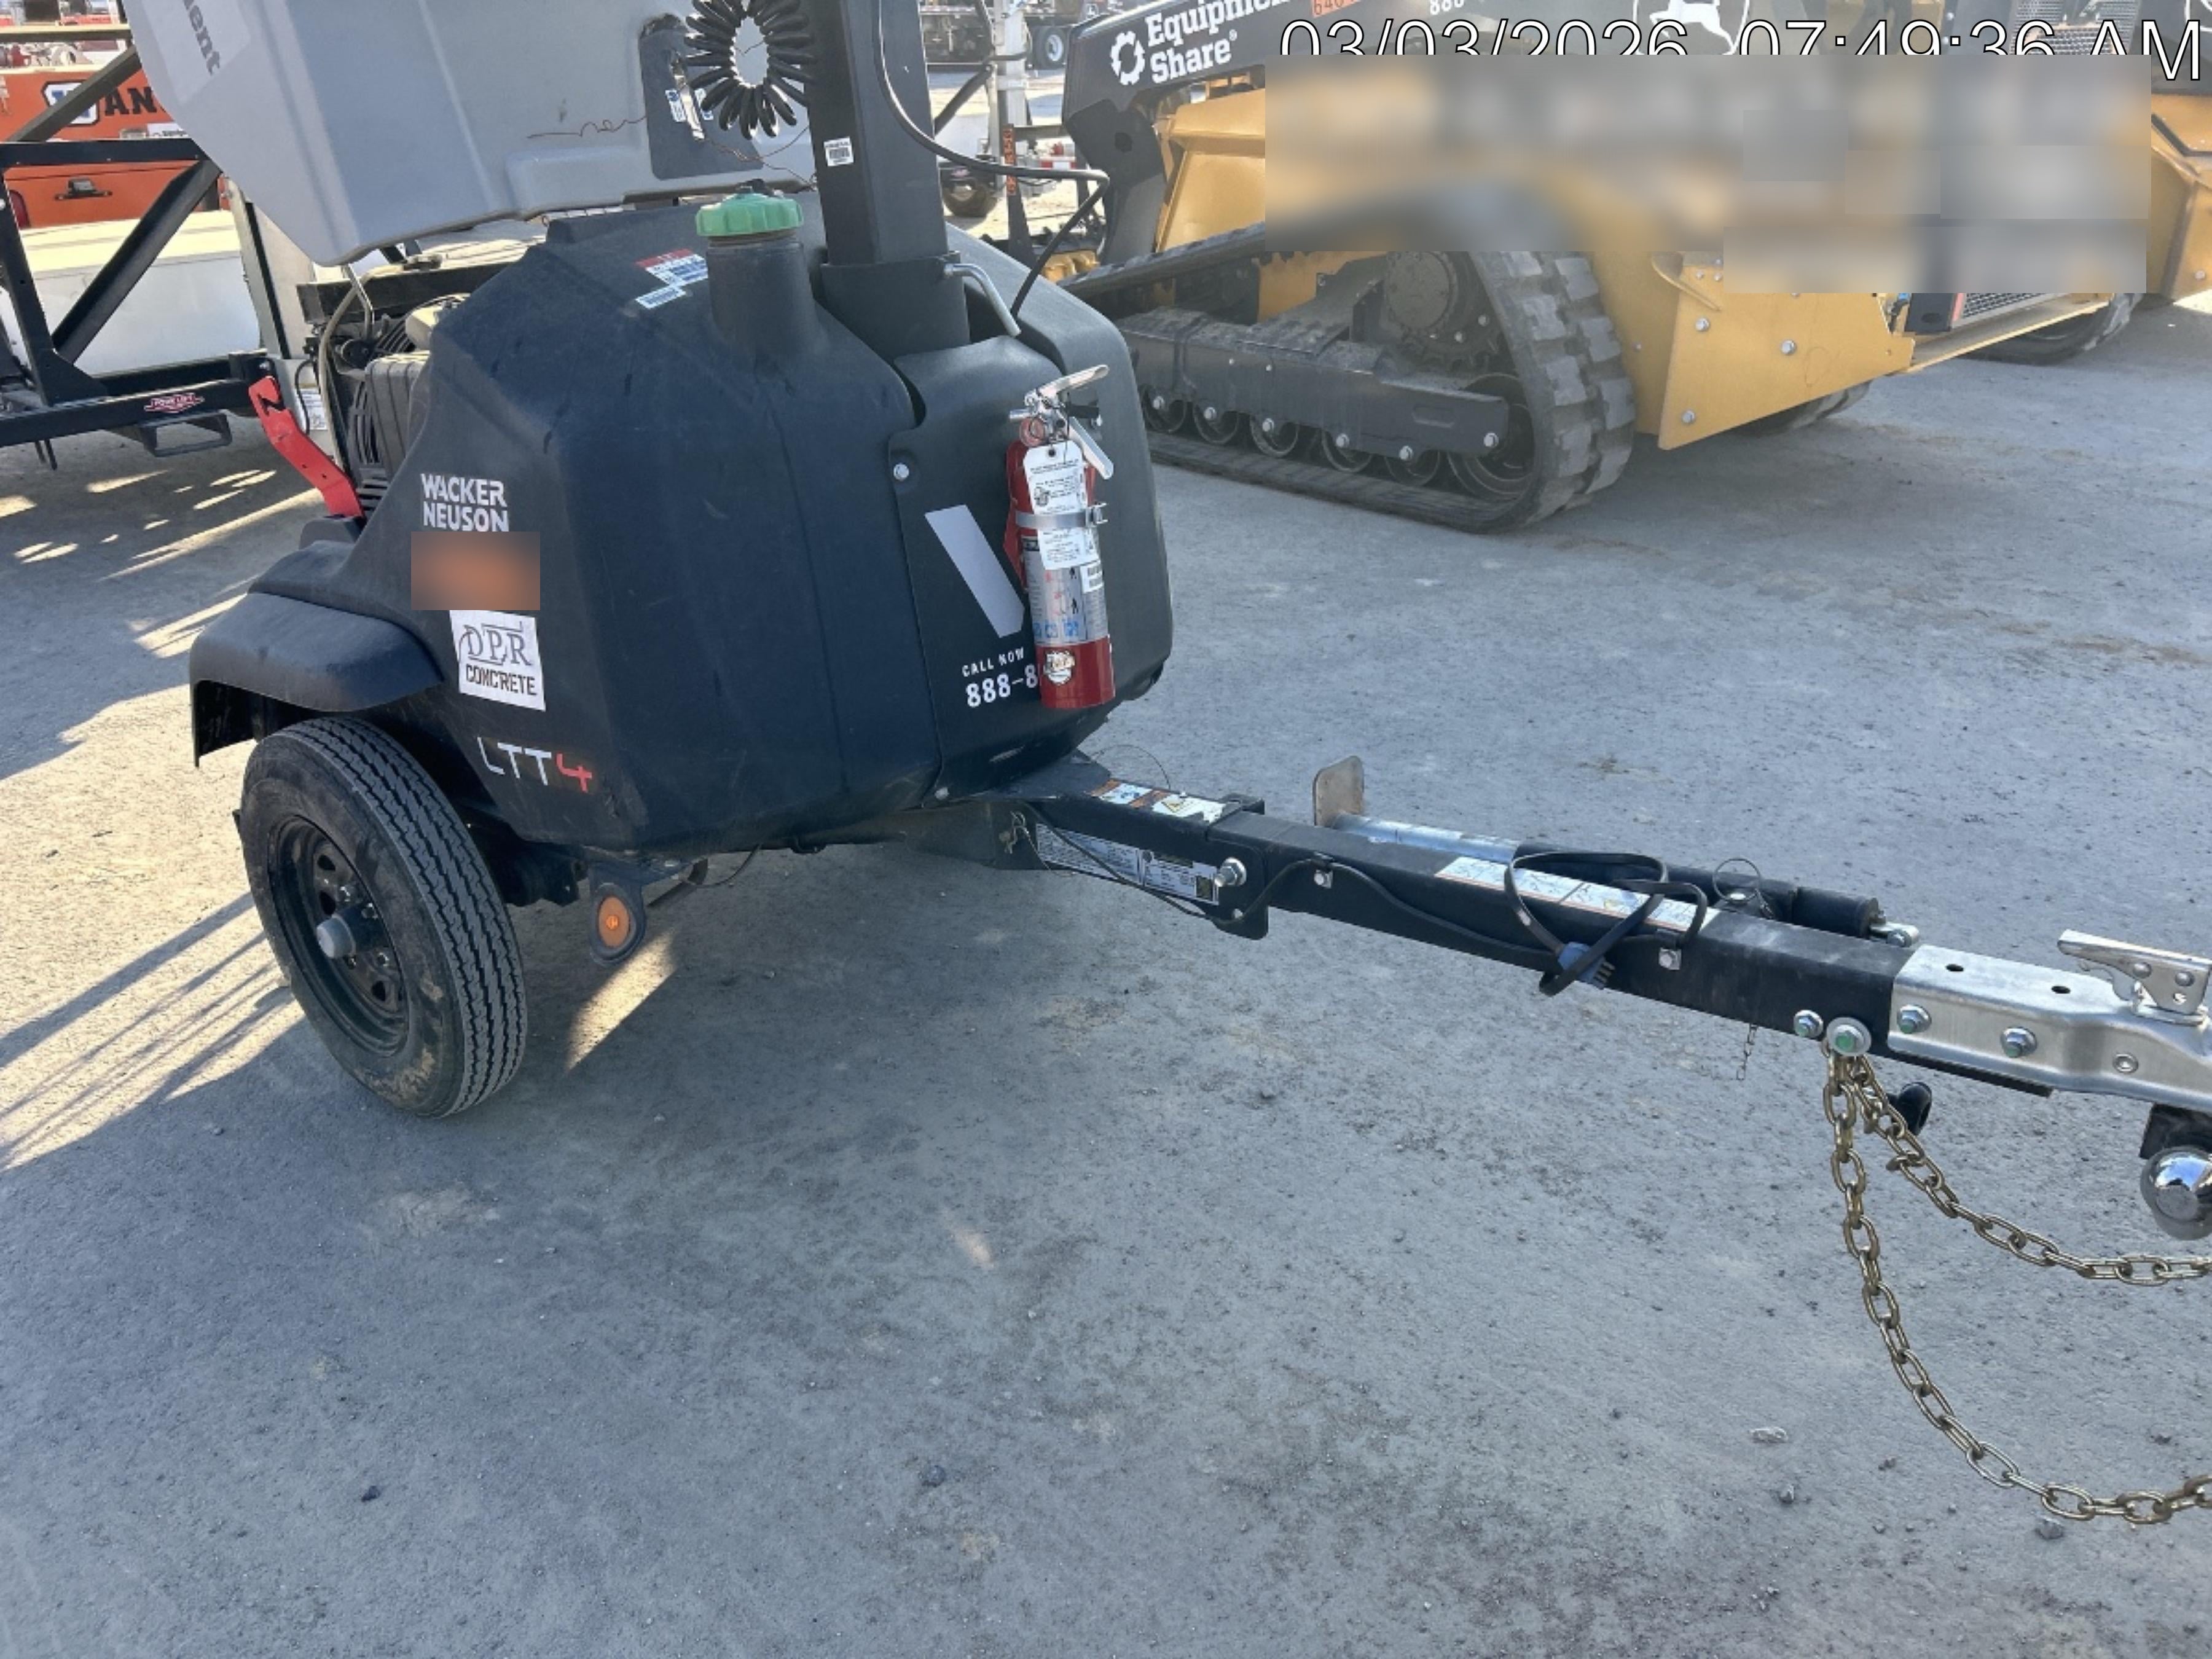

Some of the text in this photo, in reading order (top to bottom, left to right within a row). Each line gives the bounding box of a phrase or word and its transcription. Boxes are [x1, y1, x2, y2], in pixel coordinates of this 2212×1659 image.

[183, 0, 220, 76] ent
[1145, 0, 1290, 47] Equipm
[420, 473, 507, 507] WACKER
[423, 501, 509, 532] NEUSON
[962, 647, 1024, 677] CALL NOW
[466, 664, 538, 696] CONCRETE
[966, 664, 1038, 708] 888-8
